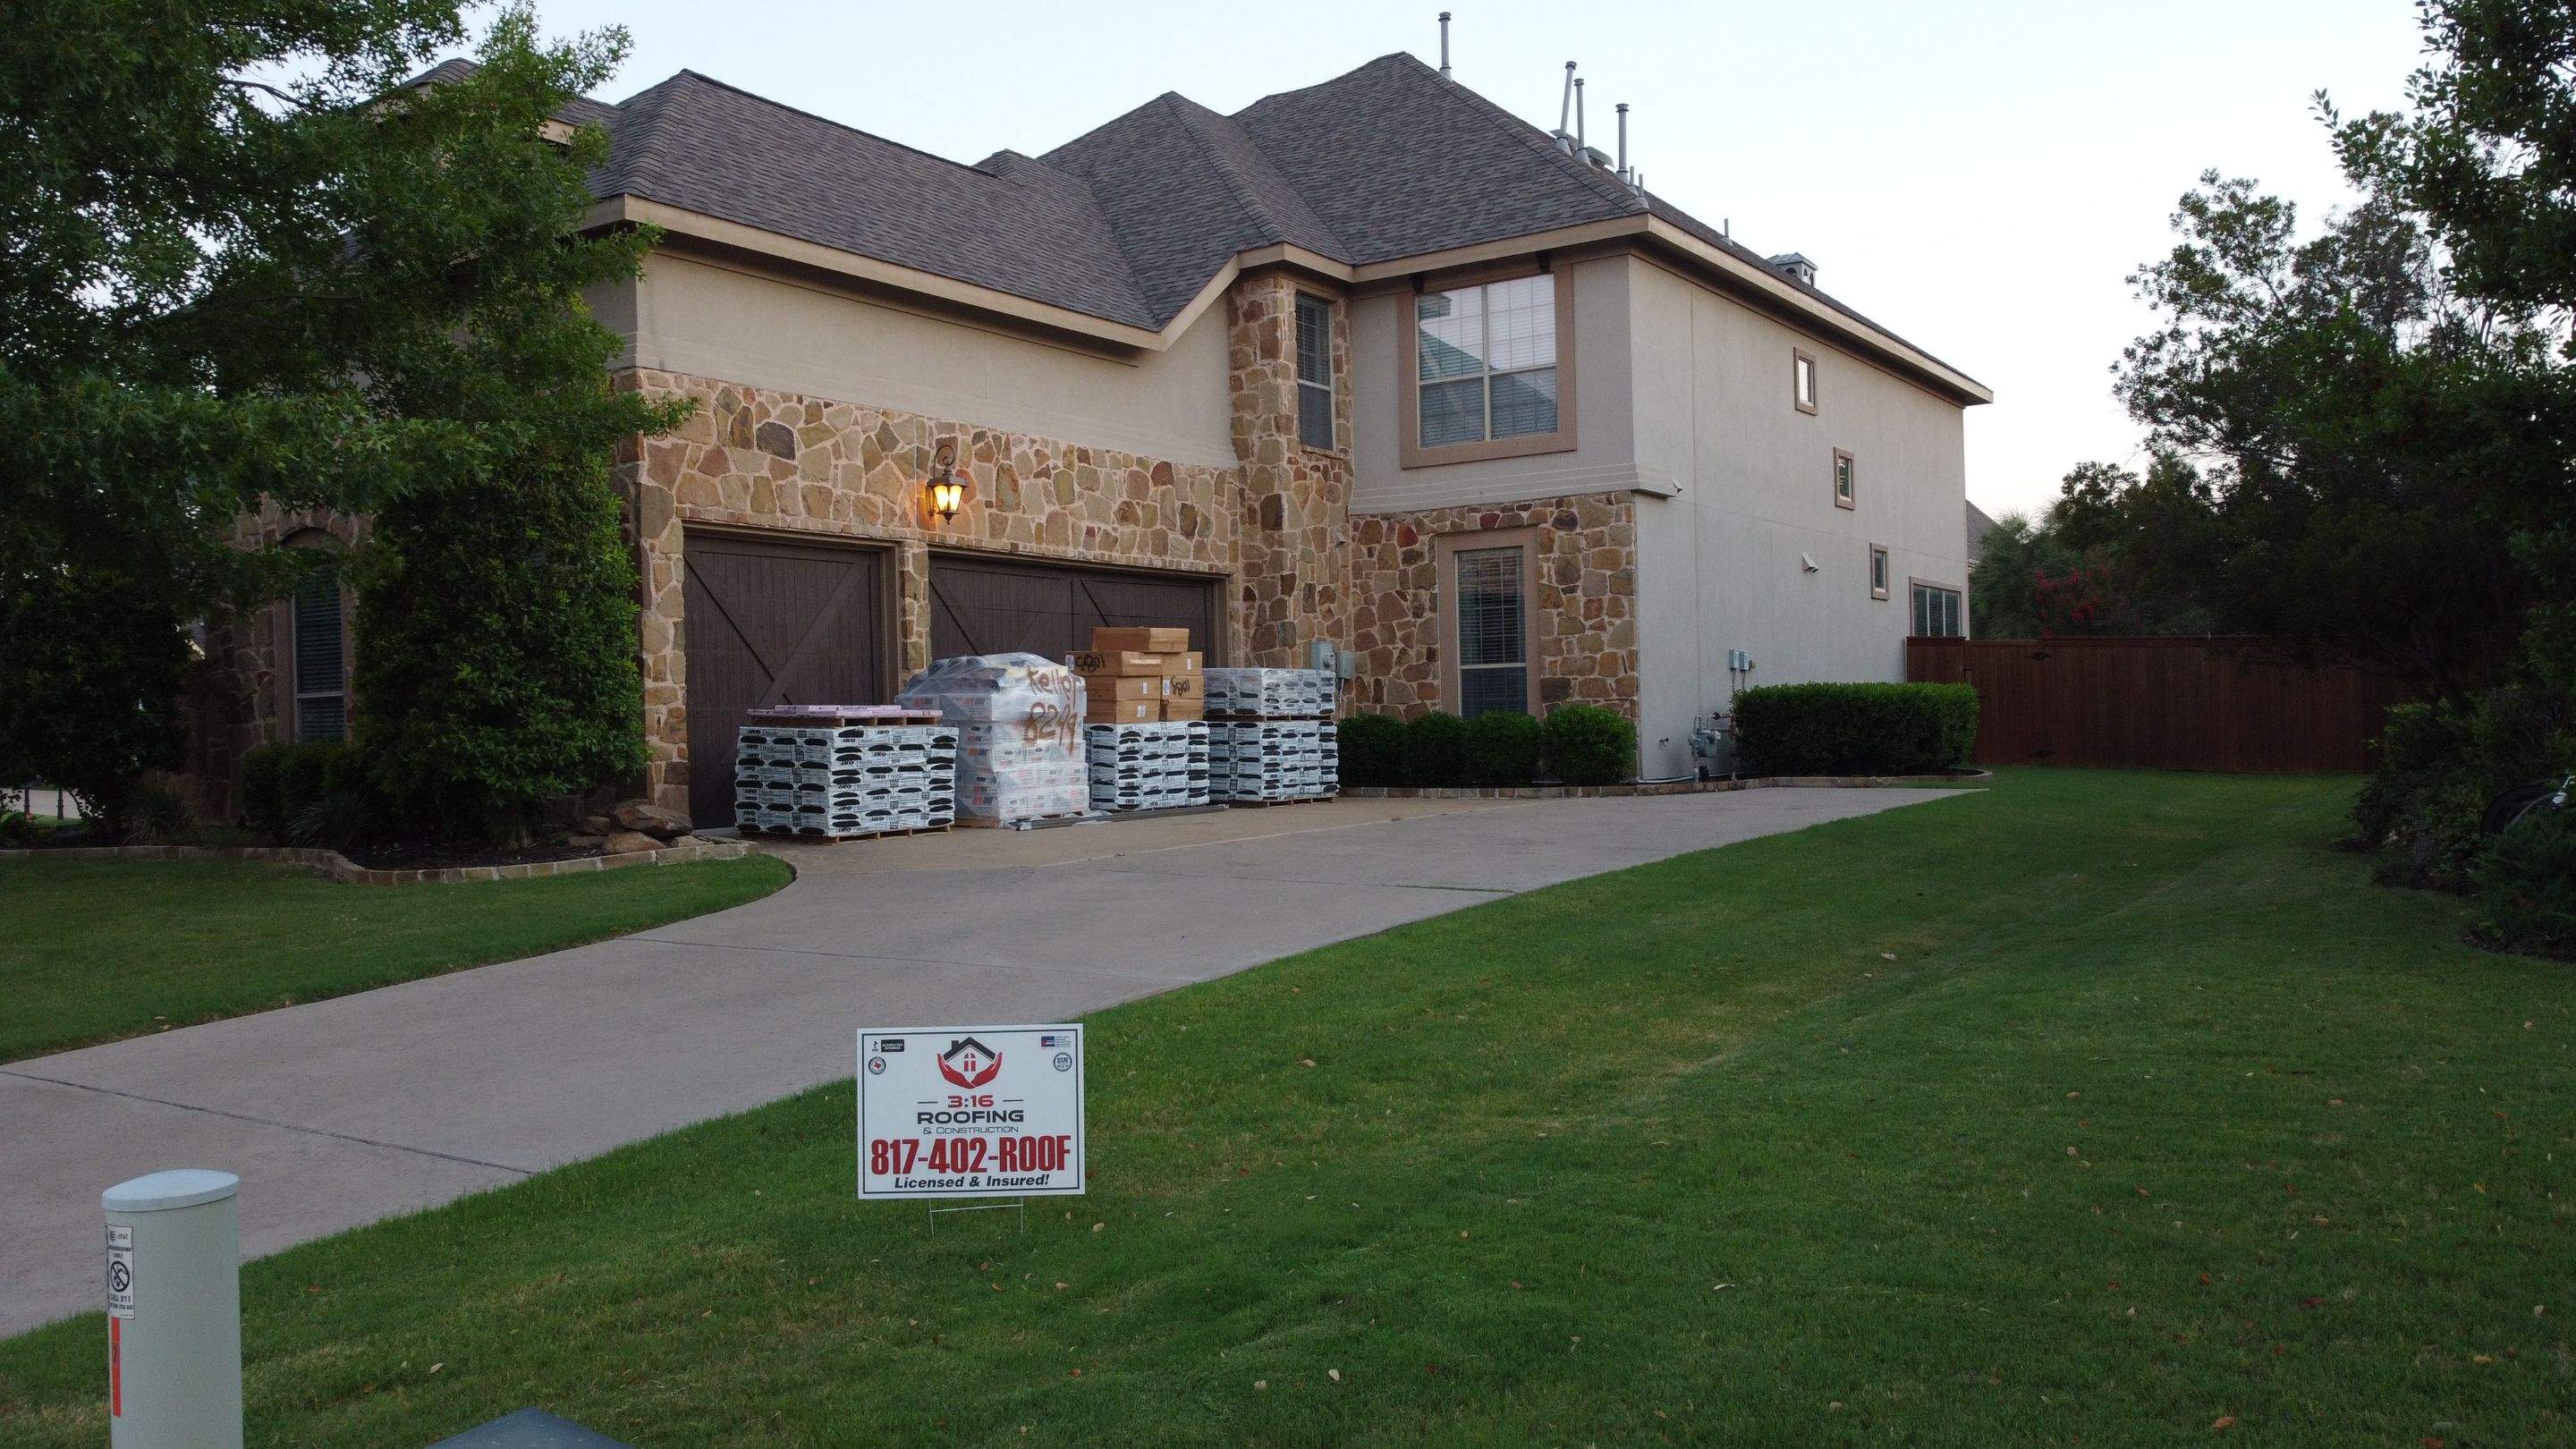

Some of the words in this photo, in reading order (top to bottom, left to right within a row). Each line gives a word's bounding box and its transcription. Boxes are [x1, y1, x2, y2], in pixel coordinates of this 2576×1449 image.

[947, 1094, 995, 1108] 3:16
[917, 1110, 1024, 1125] ROOFING
[923, 1126, 932, 1135] &
[870, 1135, 1072, 1175] 817-402-ROOF
[894, 1176, 965, 1189] Licensed
[969, 1175, 980, 1187] &
[987, 1174, 1050, 1187] Insured!
[121, 1295, 131, 1303] 811
